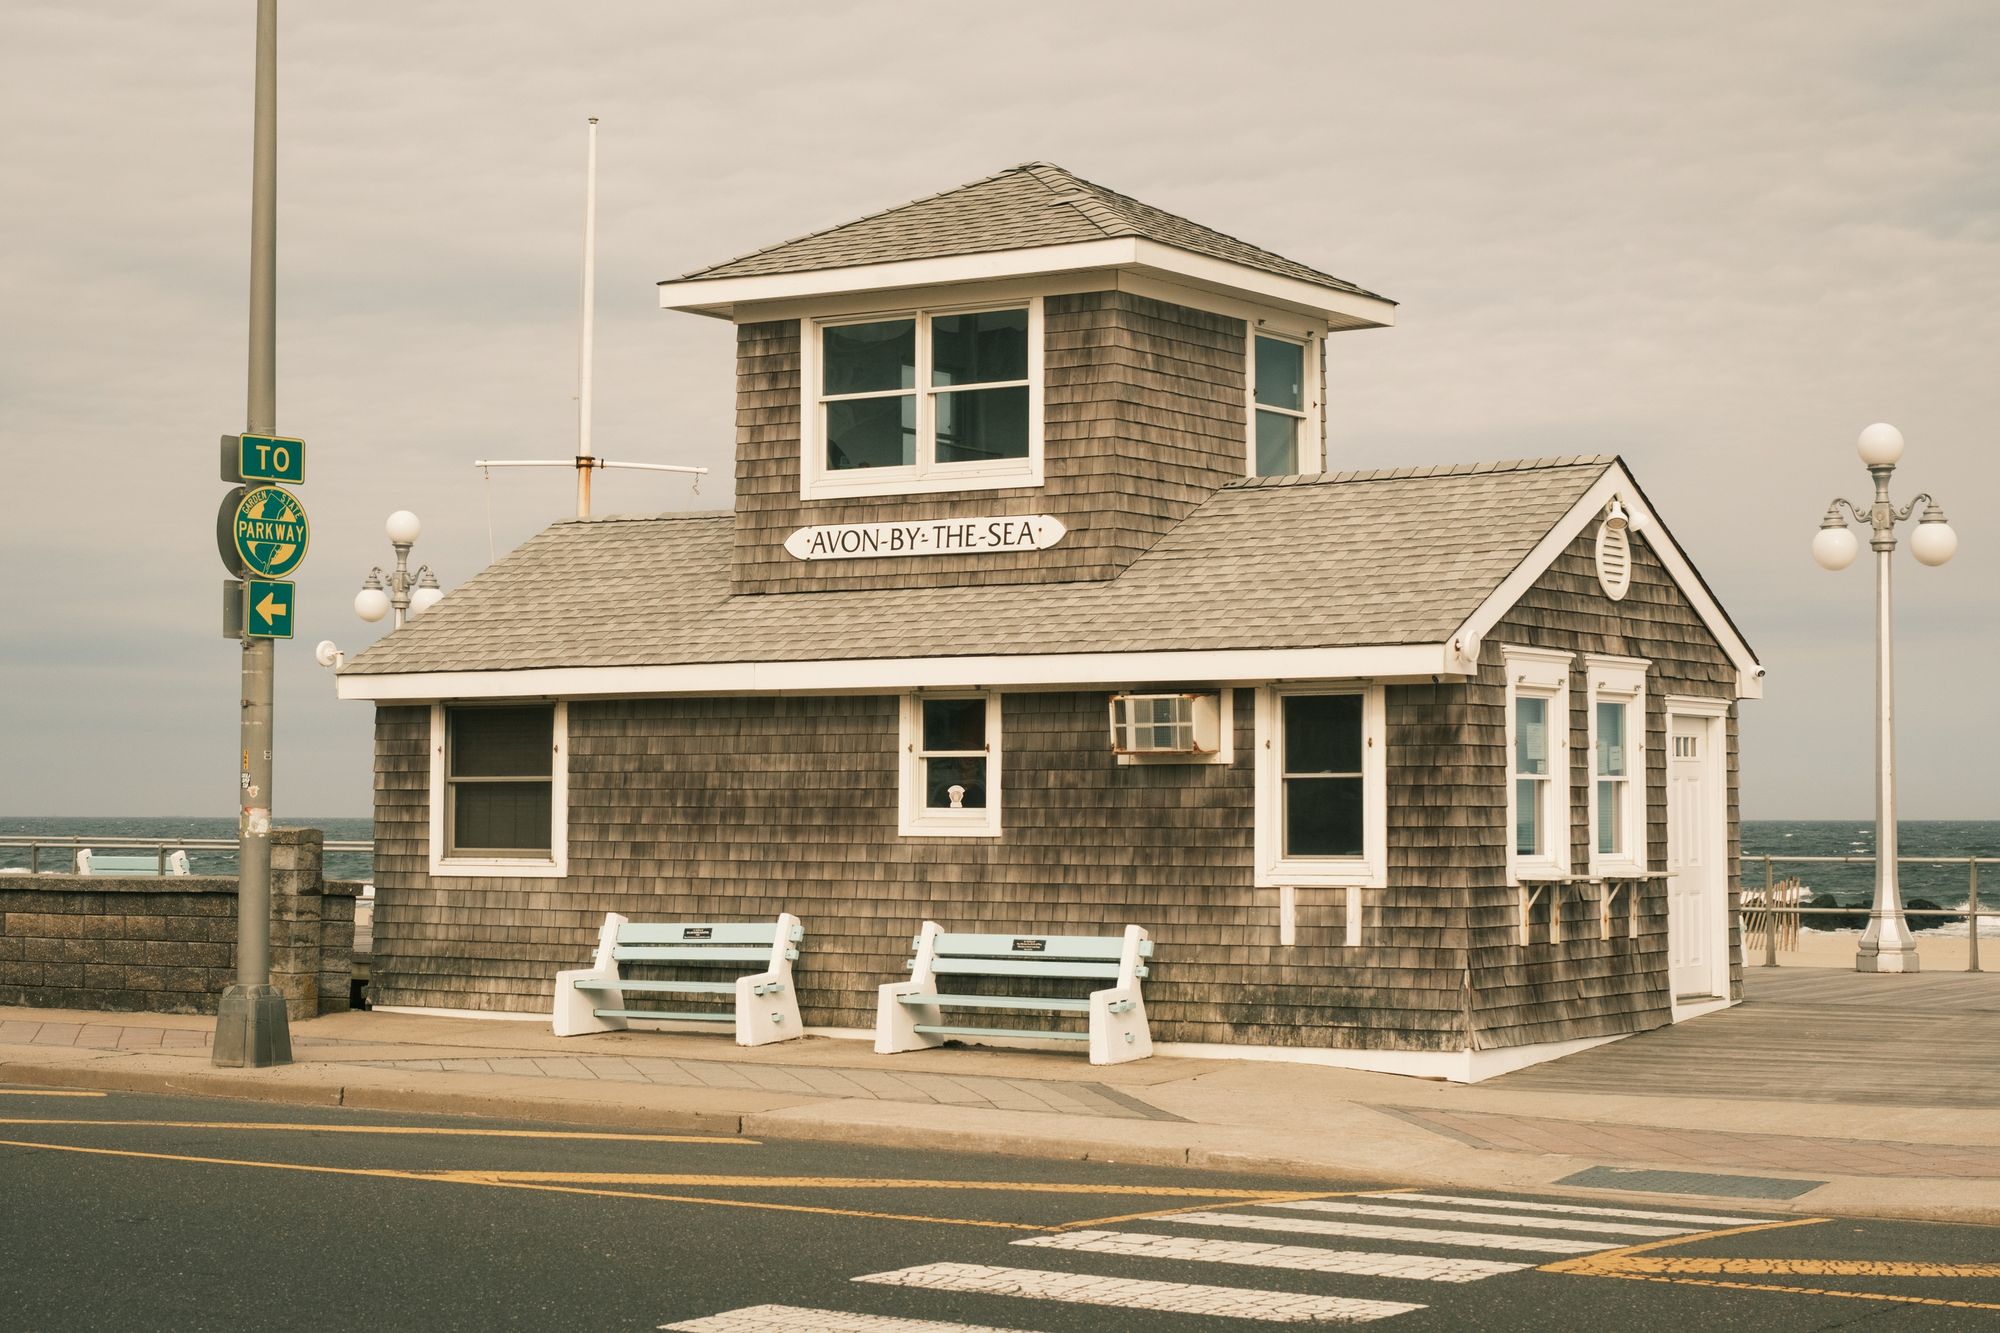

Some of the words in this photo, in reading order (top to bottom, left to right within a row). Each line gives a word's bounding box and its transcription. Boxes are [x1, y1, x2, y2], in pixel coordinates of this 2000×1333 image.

[255, 445, 290, 472] TO
[241, 490, 268, 514] GARDEN
[280, 493, 303, 519] STATE
[239, 520, 304, 542] PARKWAY
